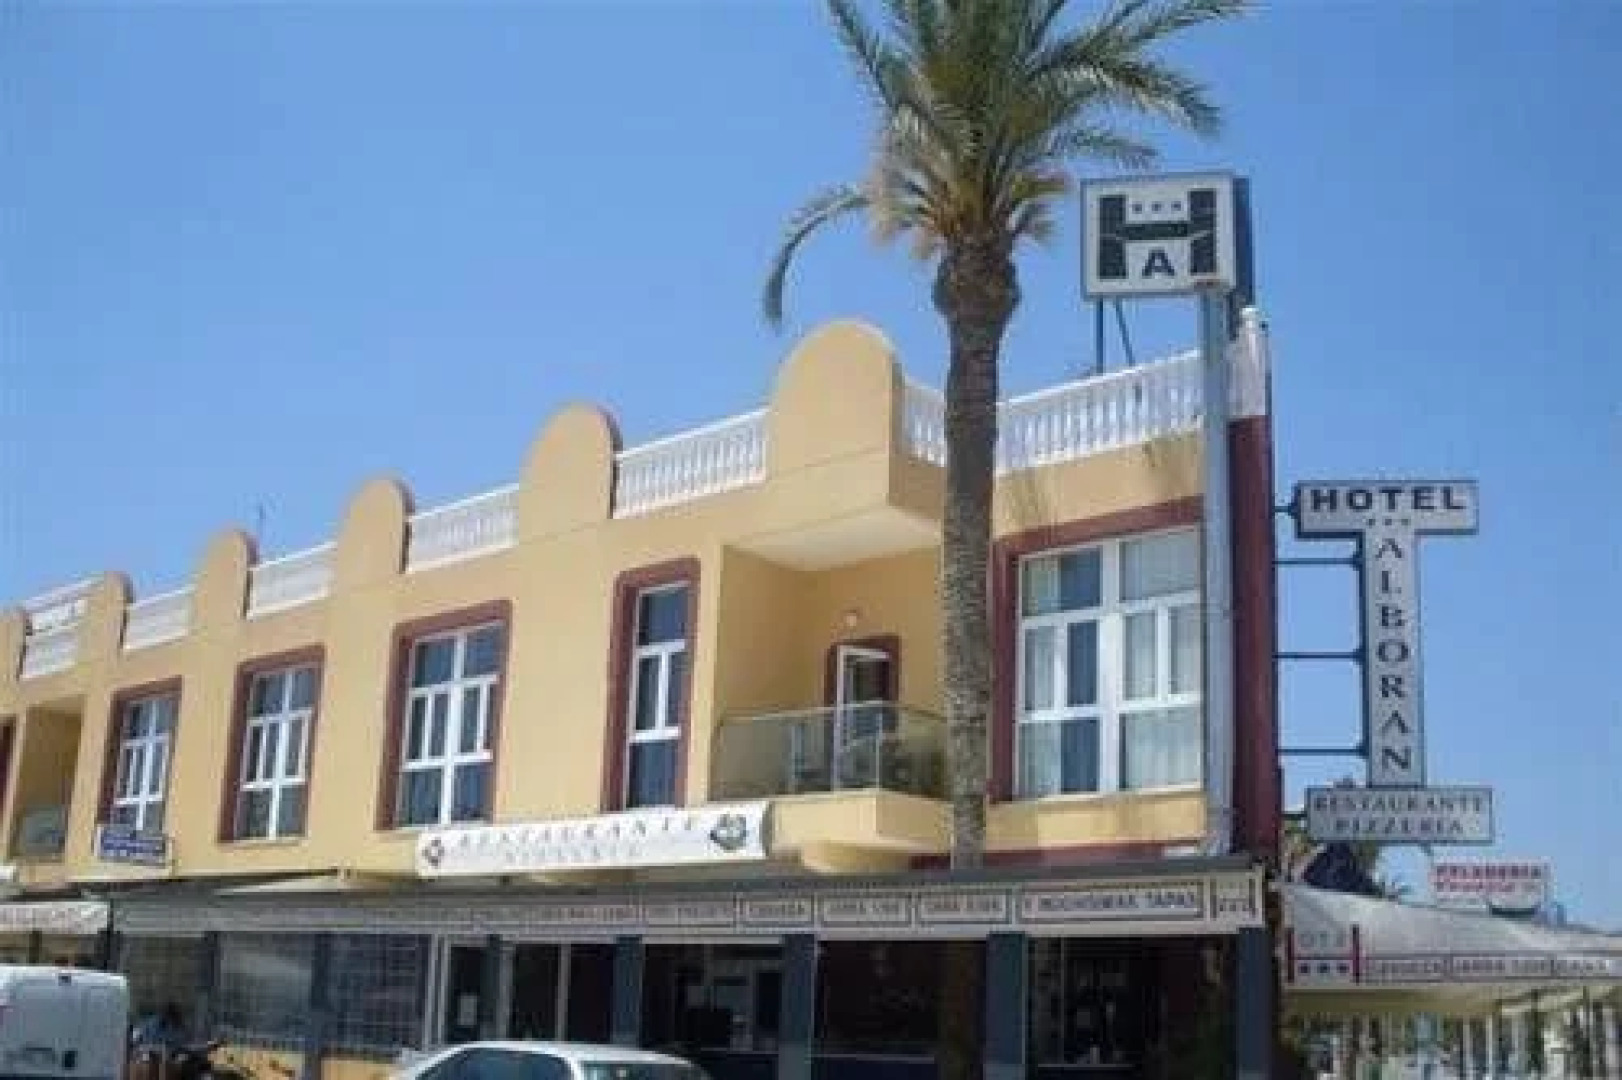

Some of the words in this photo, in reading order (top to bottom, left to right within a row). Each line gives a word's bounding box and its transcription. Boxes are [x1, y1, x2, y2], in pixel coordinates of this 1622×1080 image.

[1141, 247, 1176, 279] A
[1309, 486, 1468, 512] HOTEL
[1375, 536, 1413, 770] ALBORAN
[1313, 796, 1484, 813] RESTAURANTE
[1335, 817, 1464, 834] PIZZERIA
